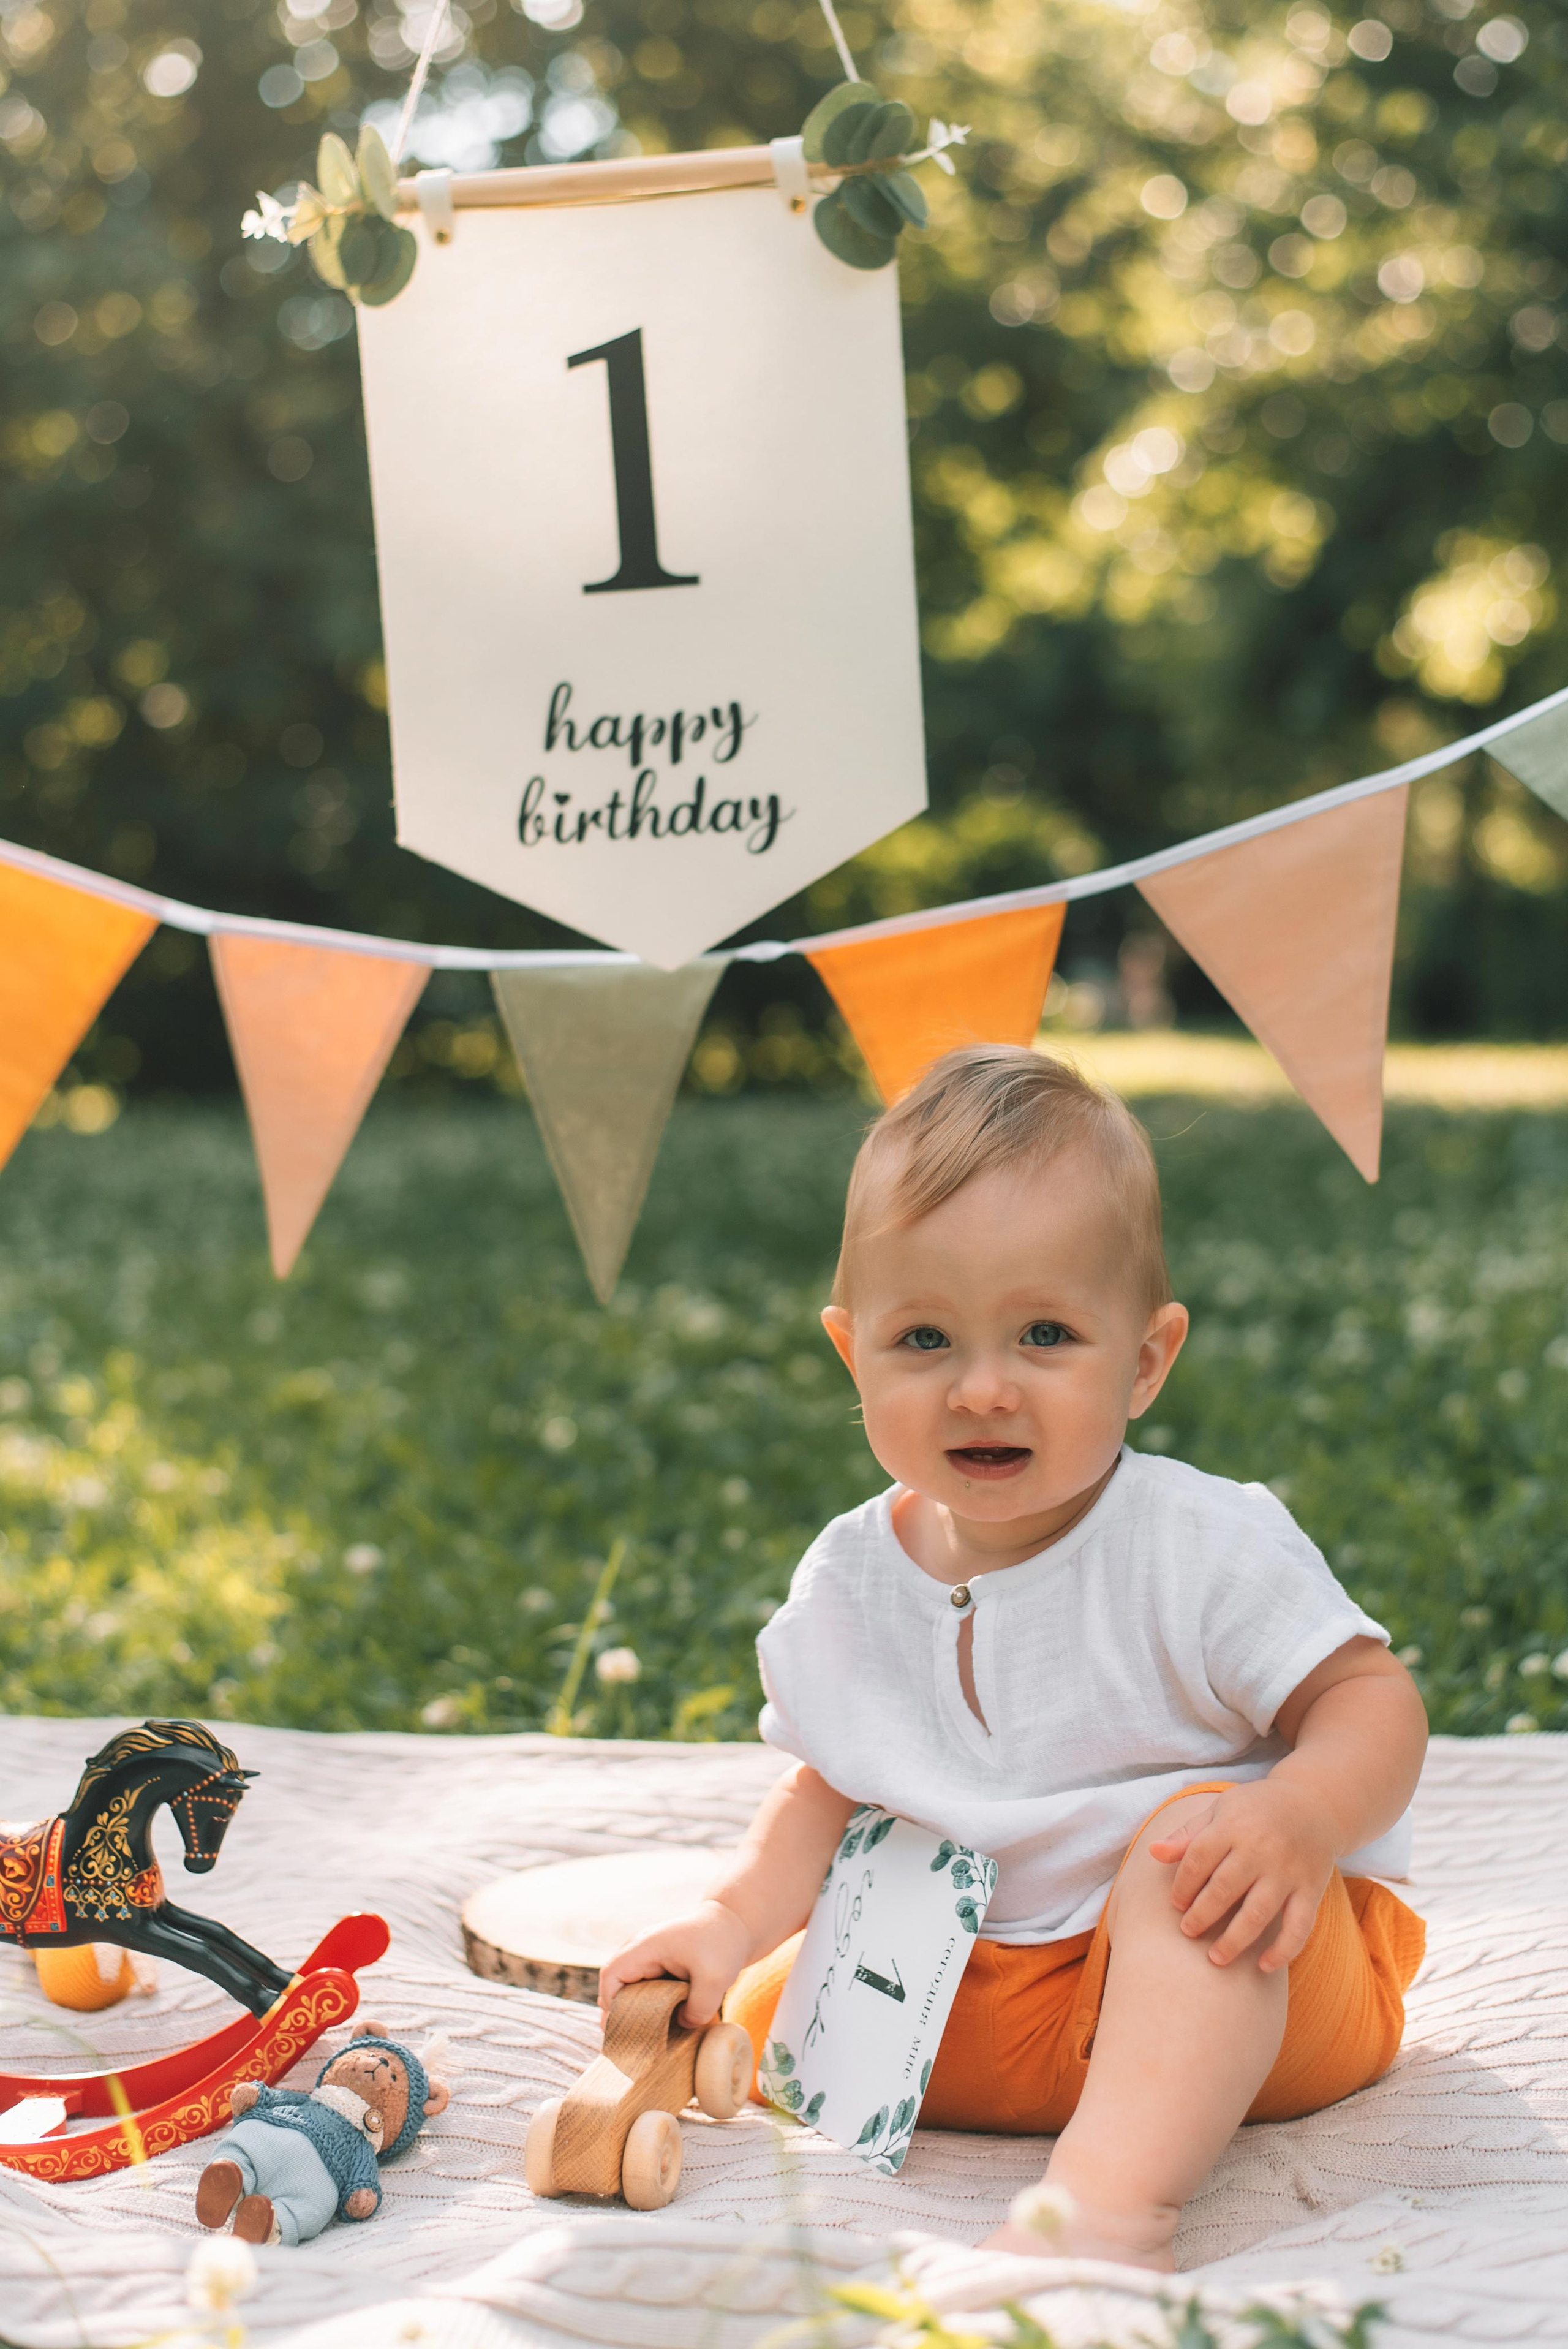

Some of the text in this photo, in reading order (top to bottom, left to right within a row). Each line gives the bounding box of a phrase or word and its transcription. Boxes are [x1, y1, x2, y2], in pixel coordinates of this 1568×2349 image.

[567, 327, 700, 594] 1
[545, 681, 758, 768] happy
[518, 768, 796, 855] birthday
[802, 1869, 873, 2062] годик
[849, 1950, 907, 2003] 1
[919, 1937, 956, 2026] сегодня
